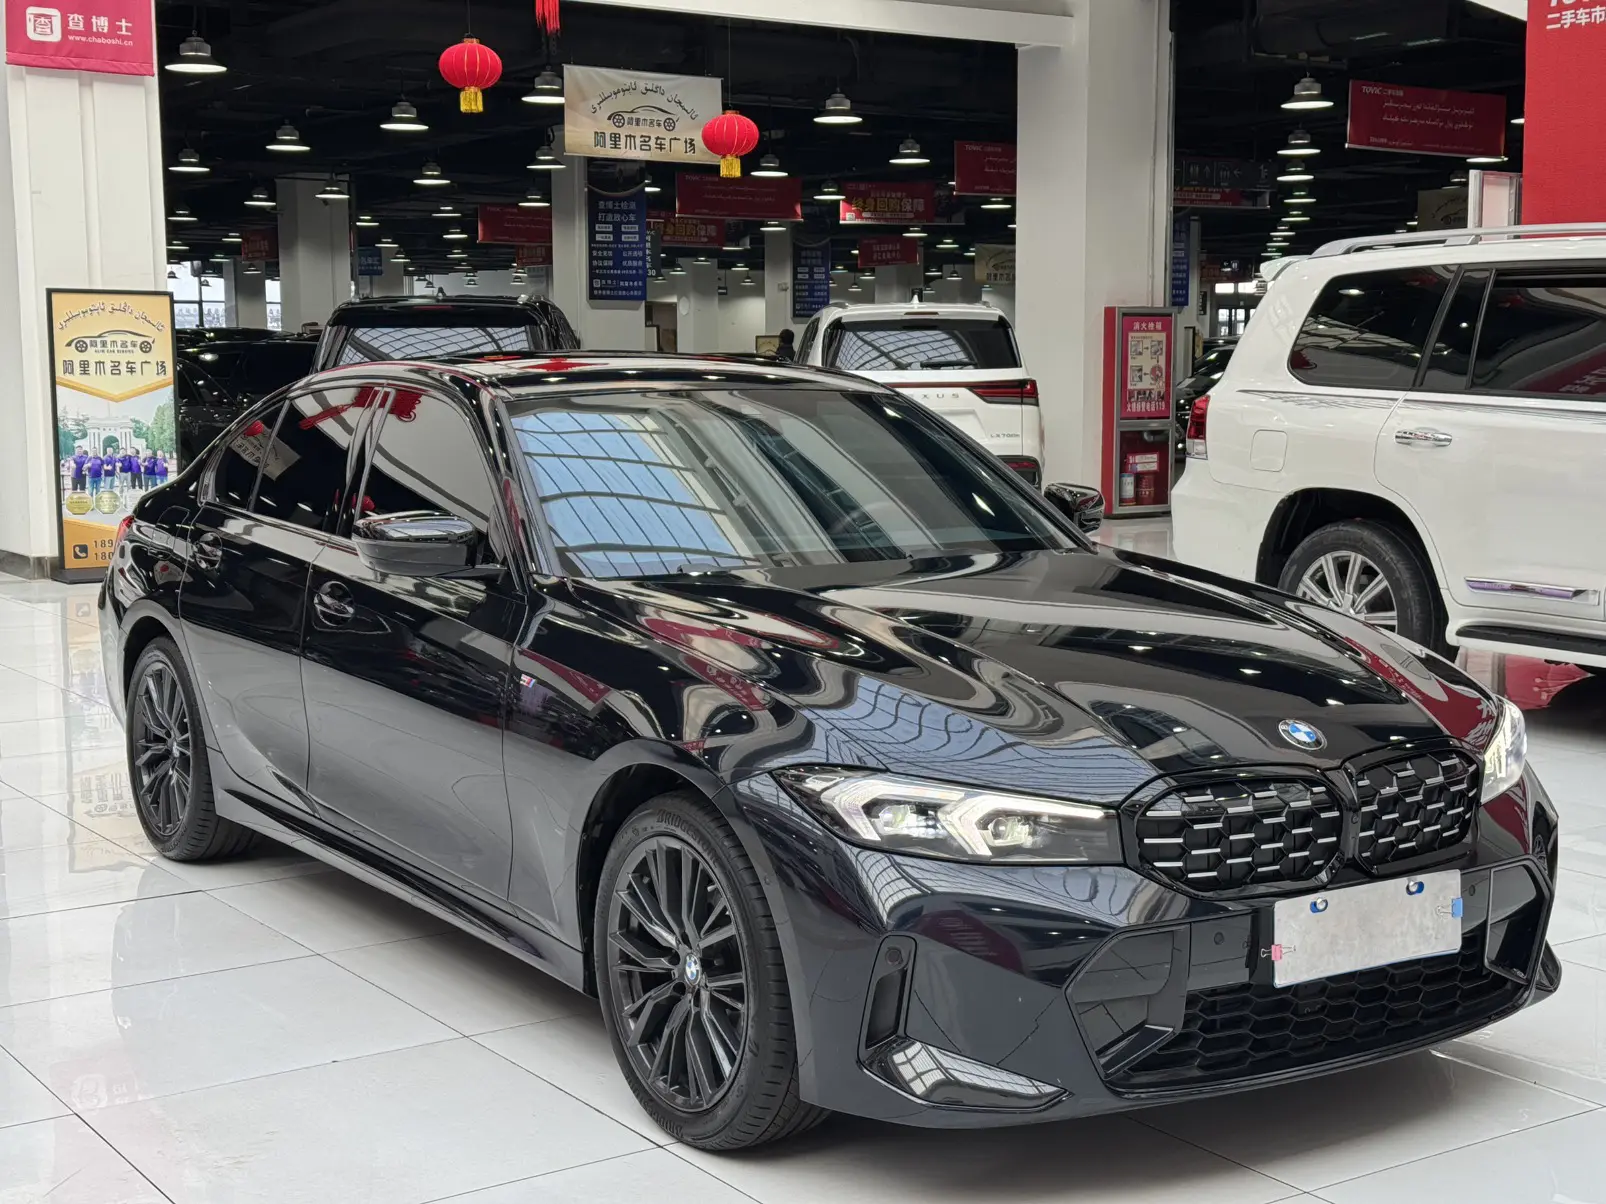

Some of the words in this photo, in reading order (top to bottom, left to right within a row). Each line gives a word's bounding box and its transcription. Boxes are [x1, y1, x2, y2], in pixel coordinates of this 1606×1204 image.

[67, 13, 133, 35] 查博士
[68, 34, 133, 46] www.chaboshi.cn
[626, 116, 662, 128] 阿里木名车
[593, 131, 696, 155] 阿里木名车广场
[986, 272, 1016, 282] 阿里木名
[89, 340, 138, 349] 阿里木名车
[62, 359, 167, 376] 阿里木名车广场
